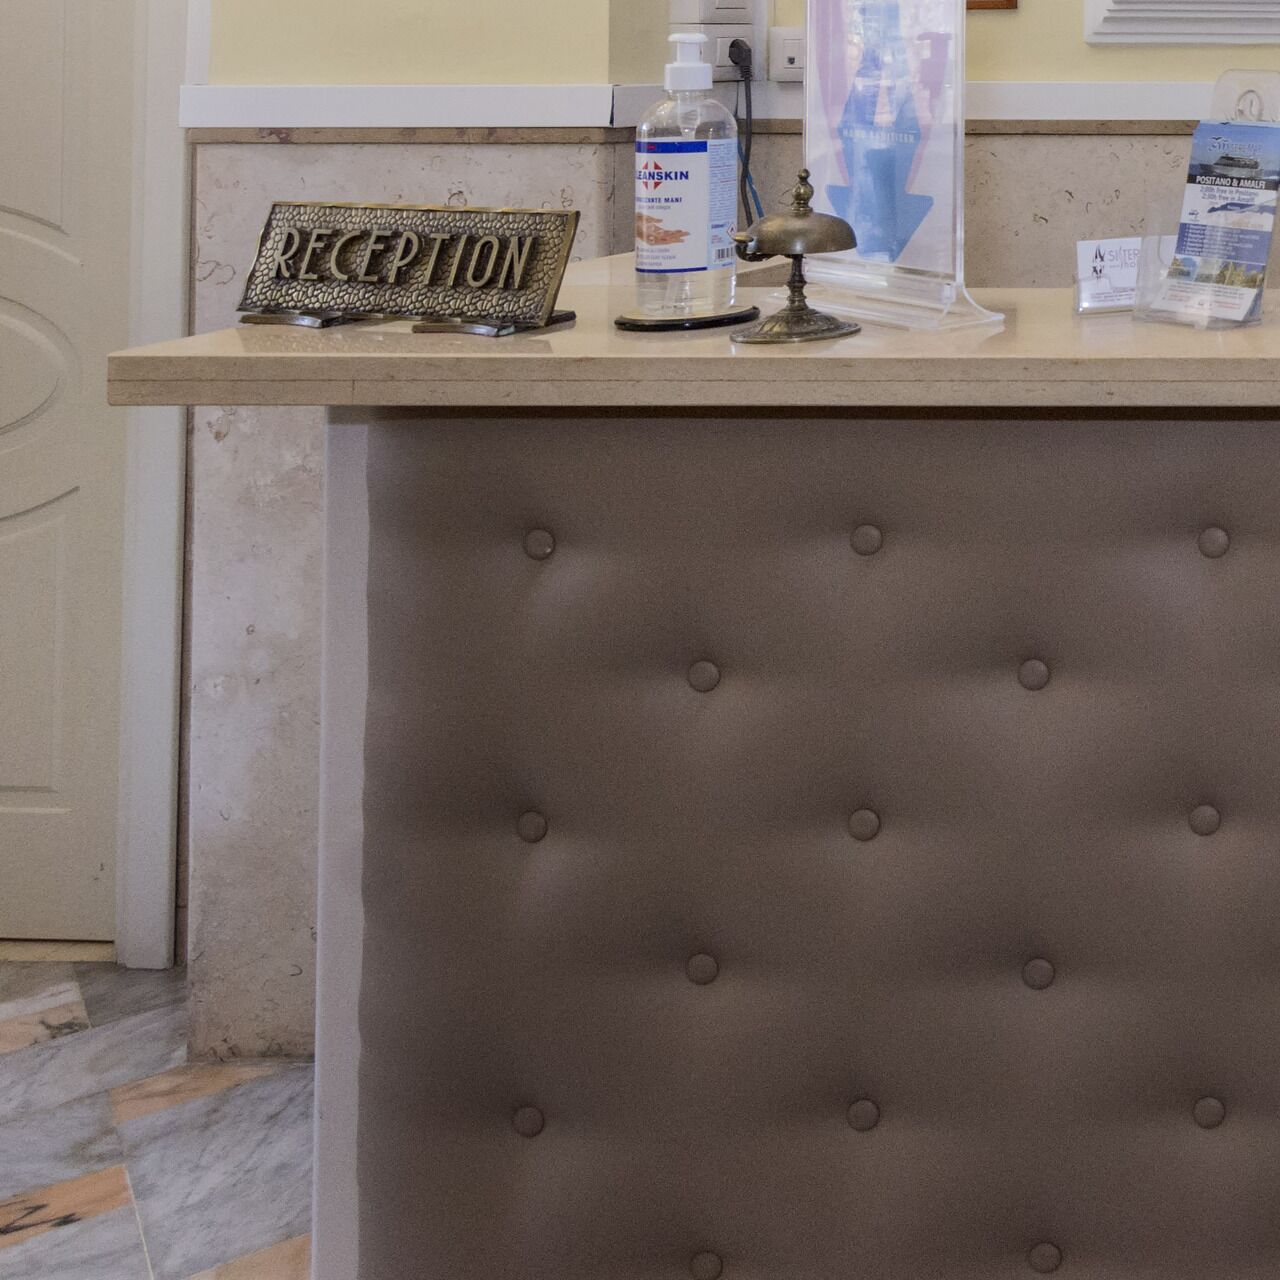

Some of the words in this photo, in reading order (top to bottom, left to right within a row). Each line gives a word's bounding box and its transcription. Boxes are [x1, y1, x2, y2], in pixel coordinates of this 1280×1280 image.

[1196, 175, 1231, 186] POSITANO
[1232, 178, 1239, 187] &
[1239, 179, 1267, 189] AMALFI
[271, 225, 534, 290] RECEPTION
